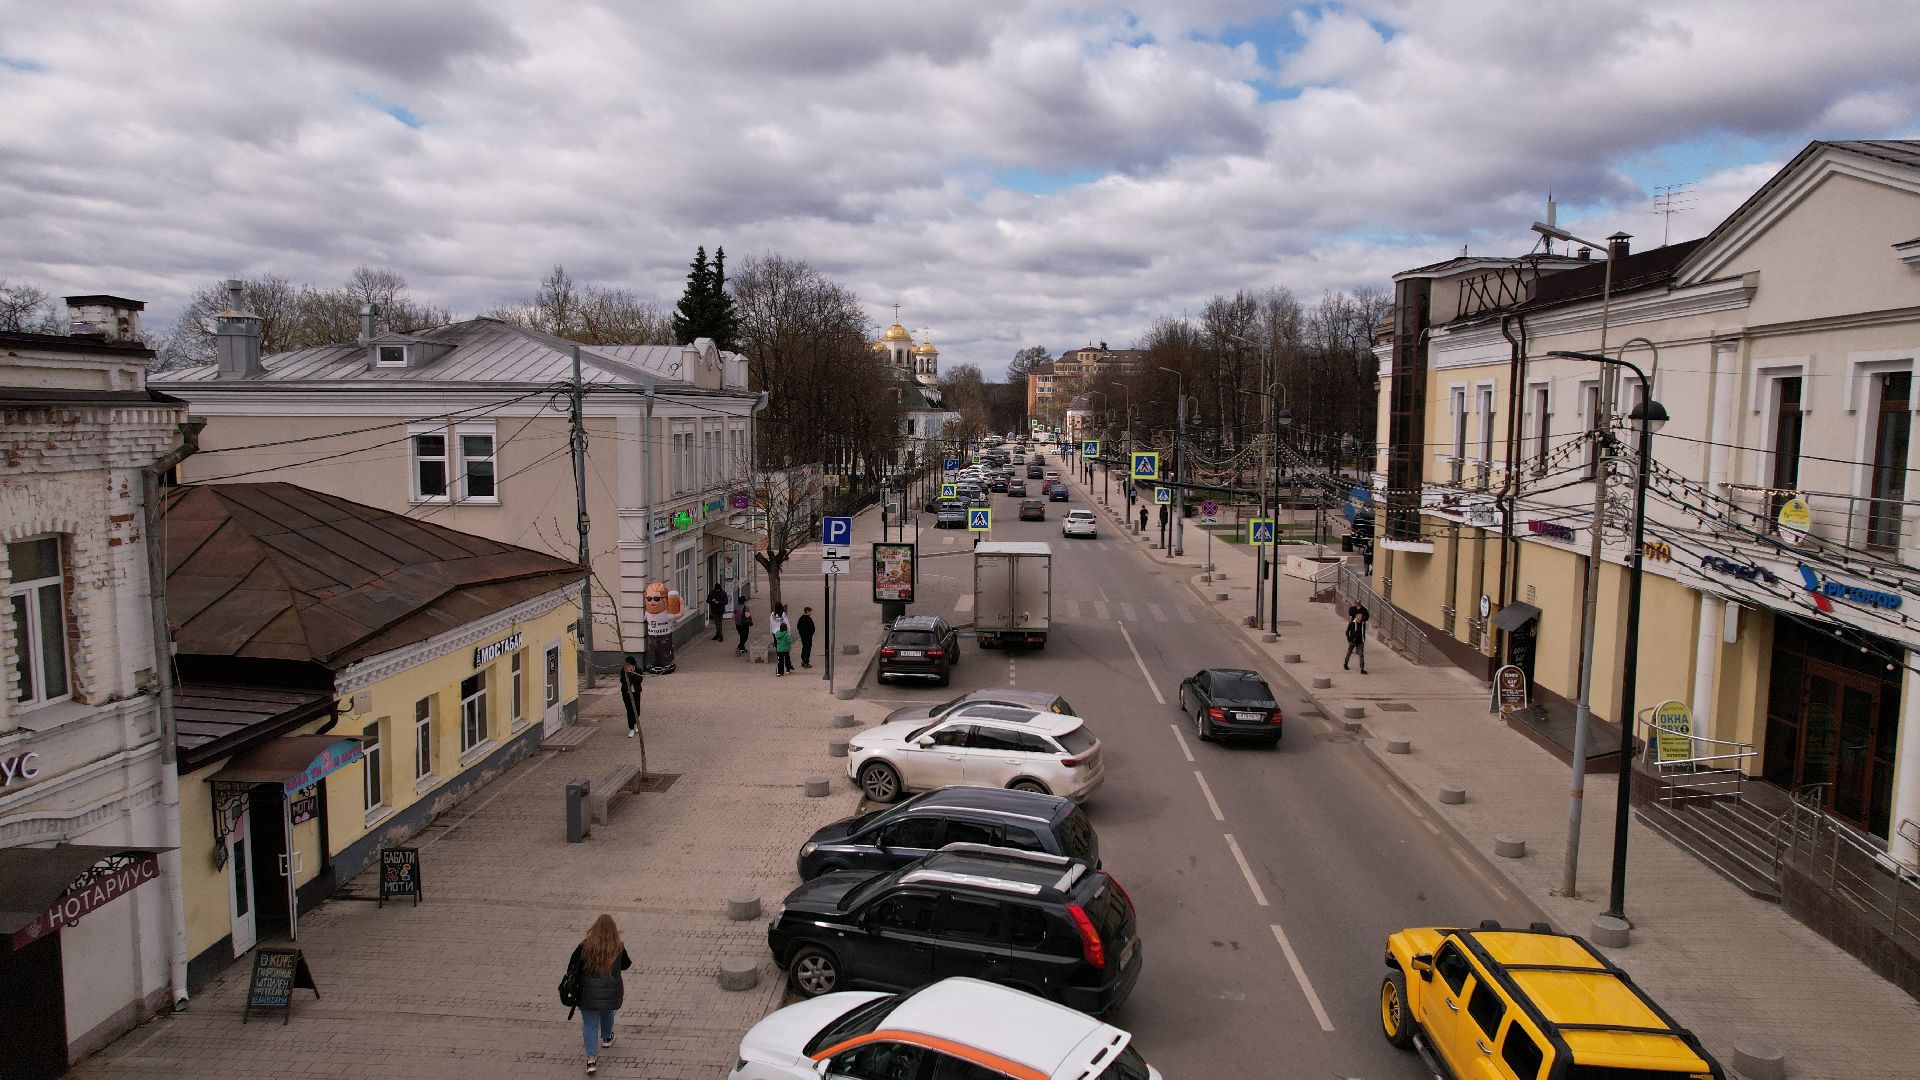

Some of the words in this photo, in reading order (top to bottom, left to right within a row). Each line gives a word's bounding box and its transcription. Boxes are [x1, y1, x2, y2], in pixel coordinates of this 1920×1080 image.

[830, 520, 847, 543] P
[1642, 542, 1672, 563] ОТО
[1660, 714, 1689, 724] ОКНА
[50, 859, 154, 928] НОТАРИУС
[384, 881, 414, 892] МОТИ
[270, 955, 294, 967] КОФЕ
